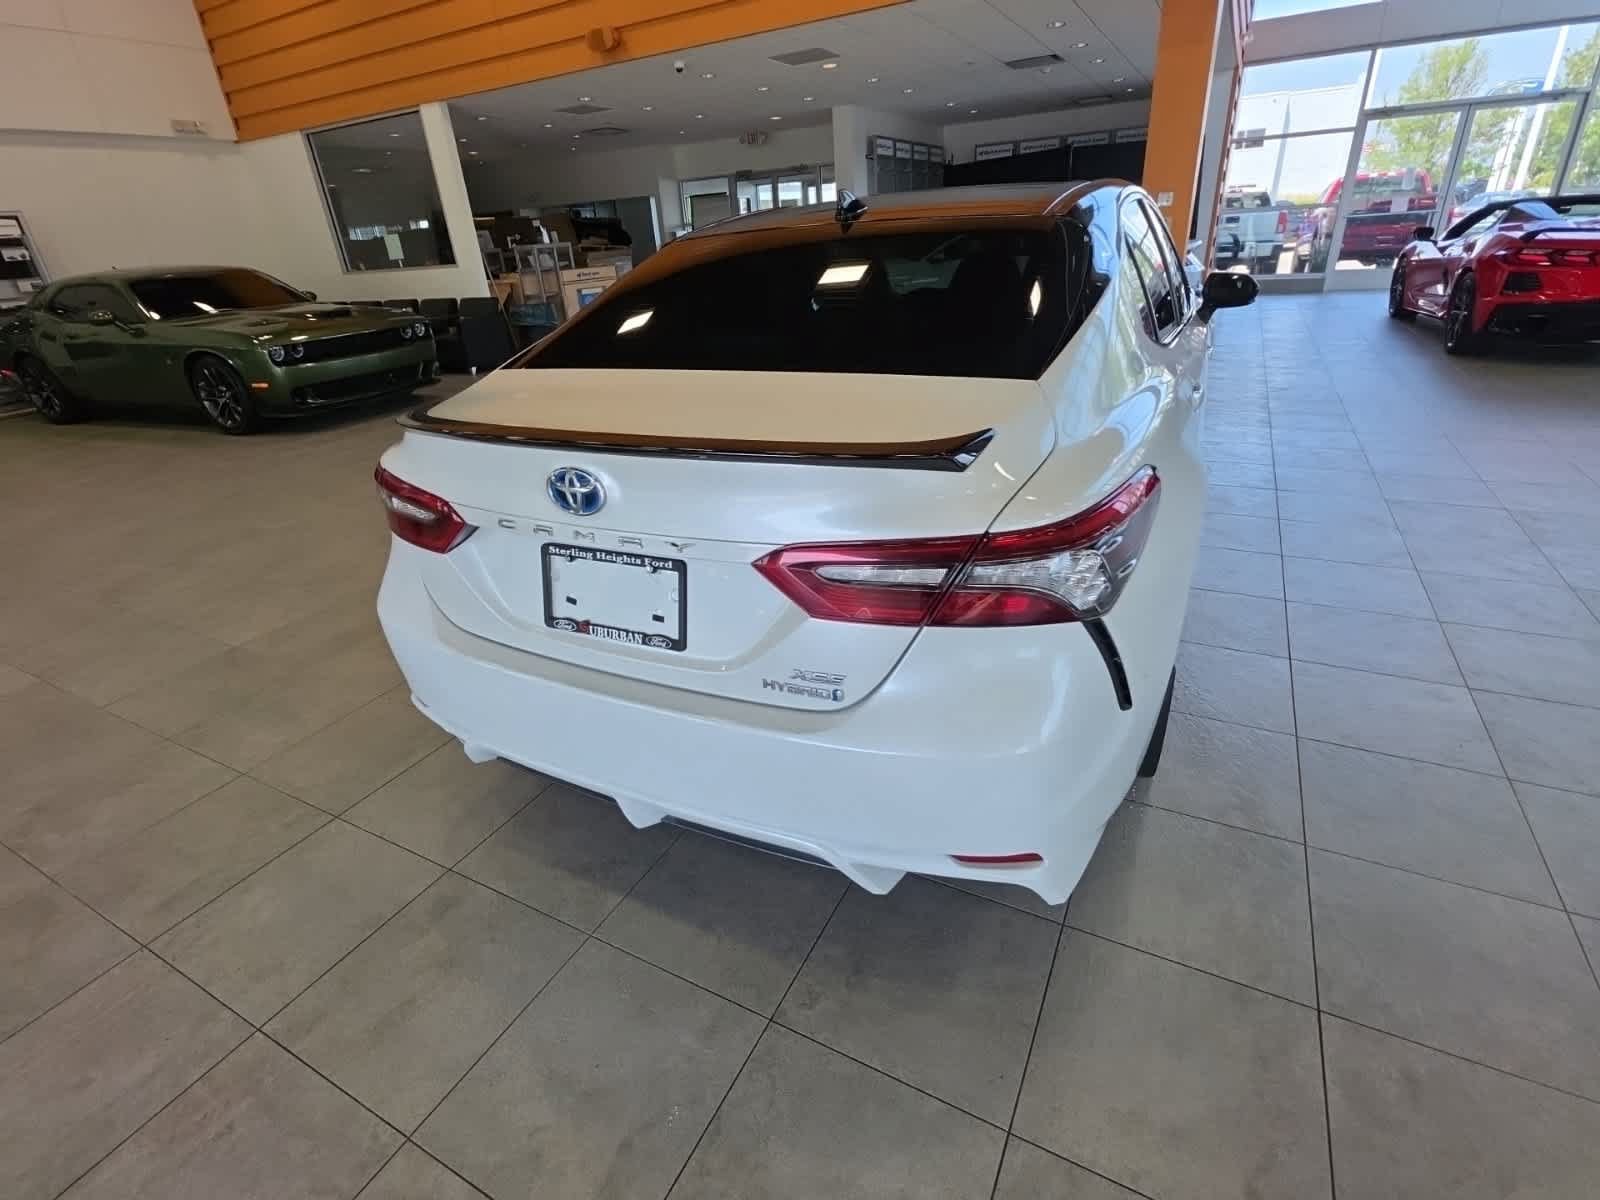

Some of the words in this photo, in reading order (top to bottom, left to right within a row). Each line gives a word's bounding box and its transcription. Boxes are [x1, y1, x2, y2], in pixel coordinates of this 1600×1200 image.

[497, 518, 697, 553] CAMRY
[548, 545, 594, 560] Sterling
[596, 551, 642, 565] Heights
[644, 557, 674, 569] Ford
[648, 636, 670, 648] Ford
